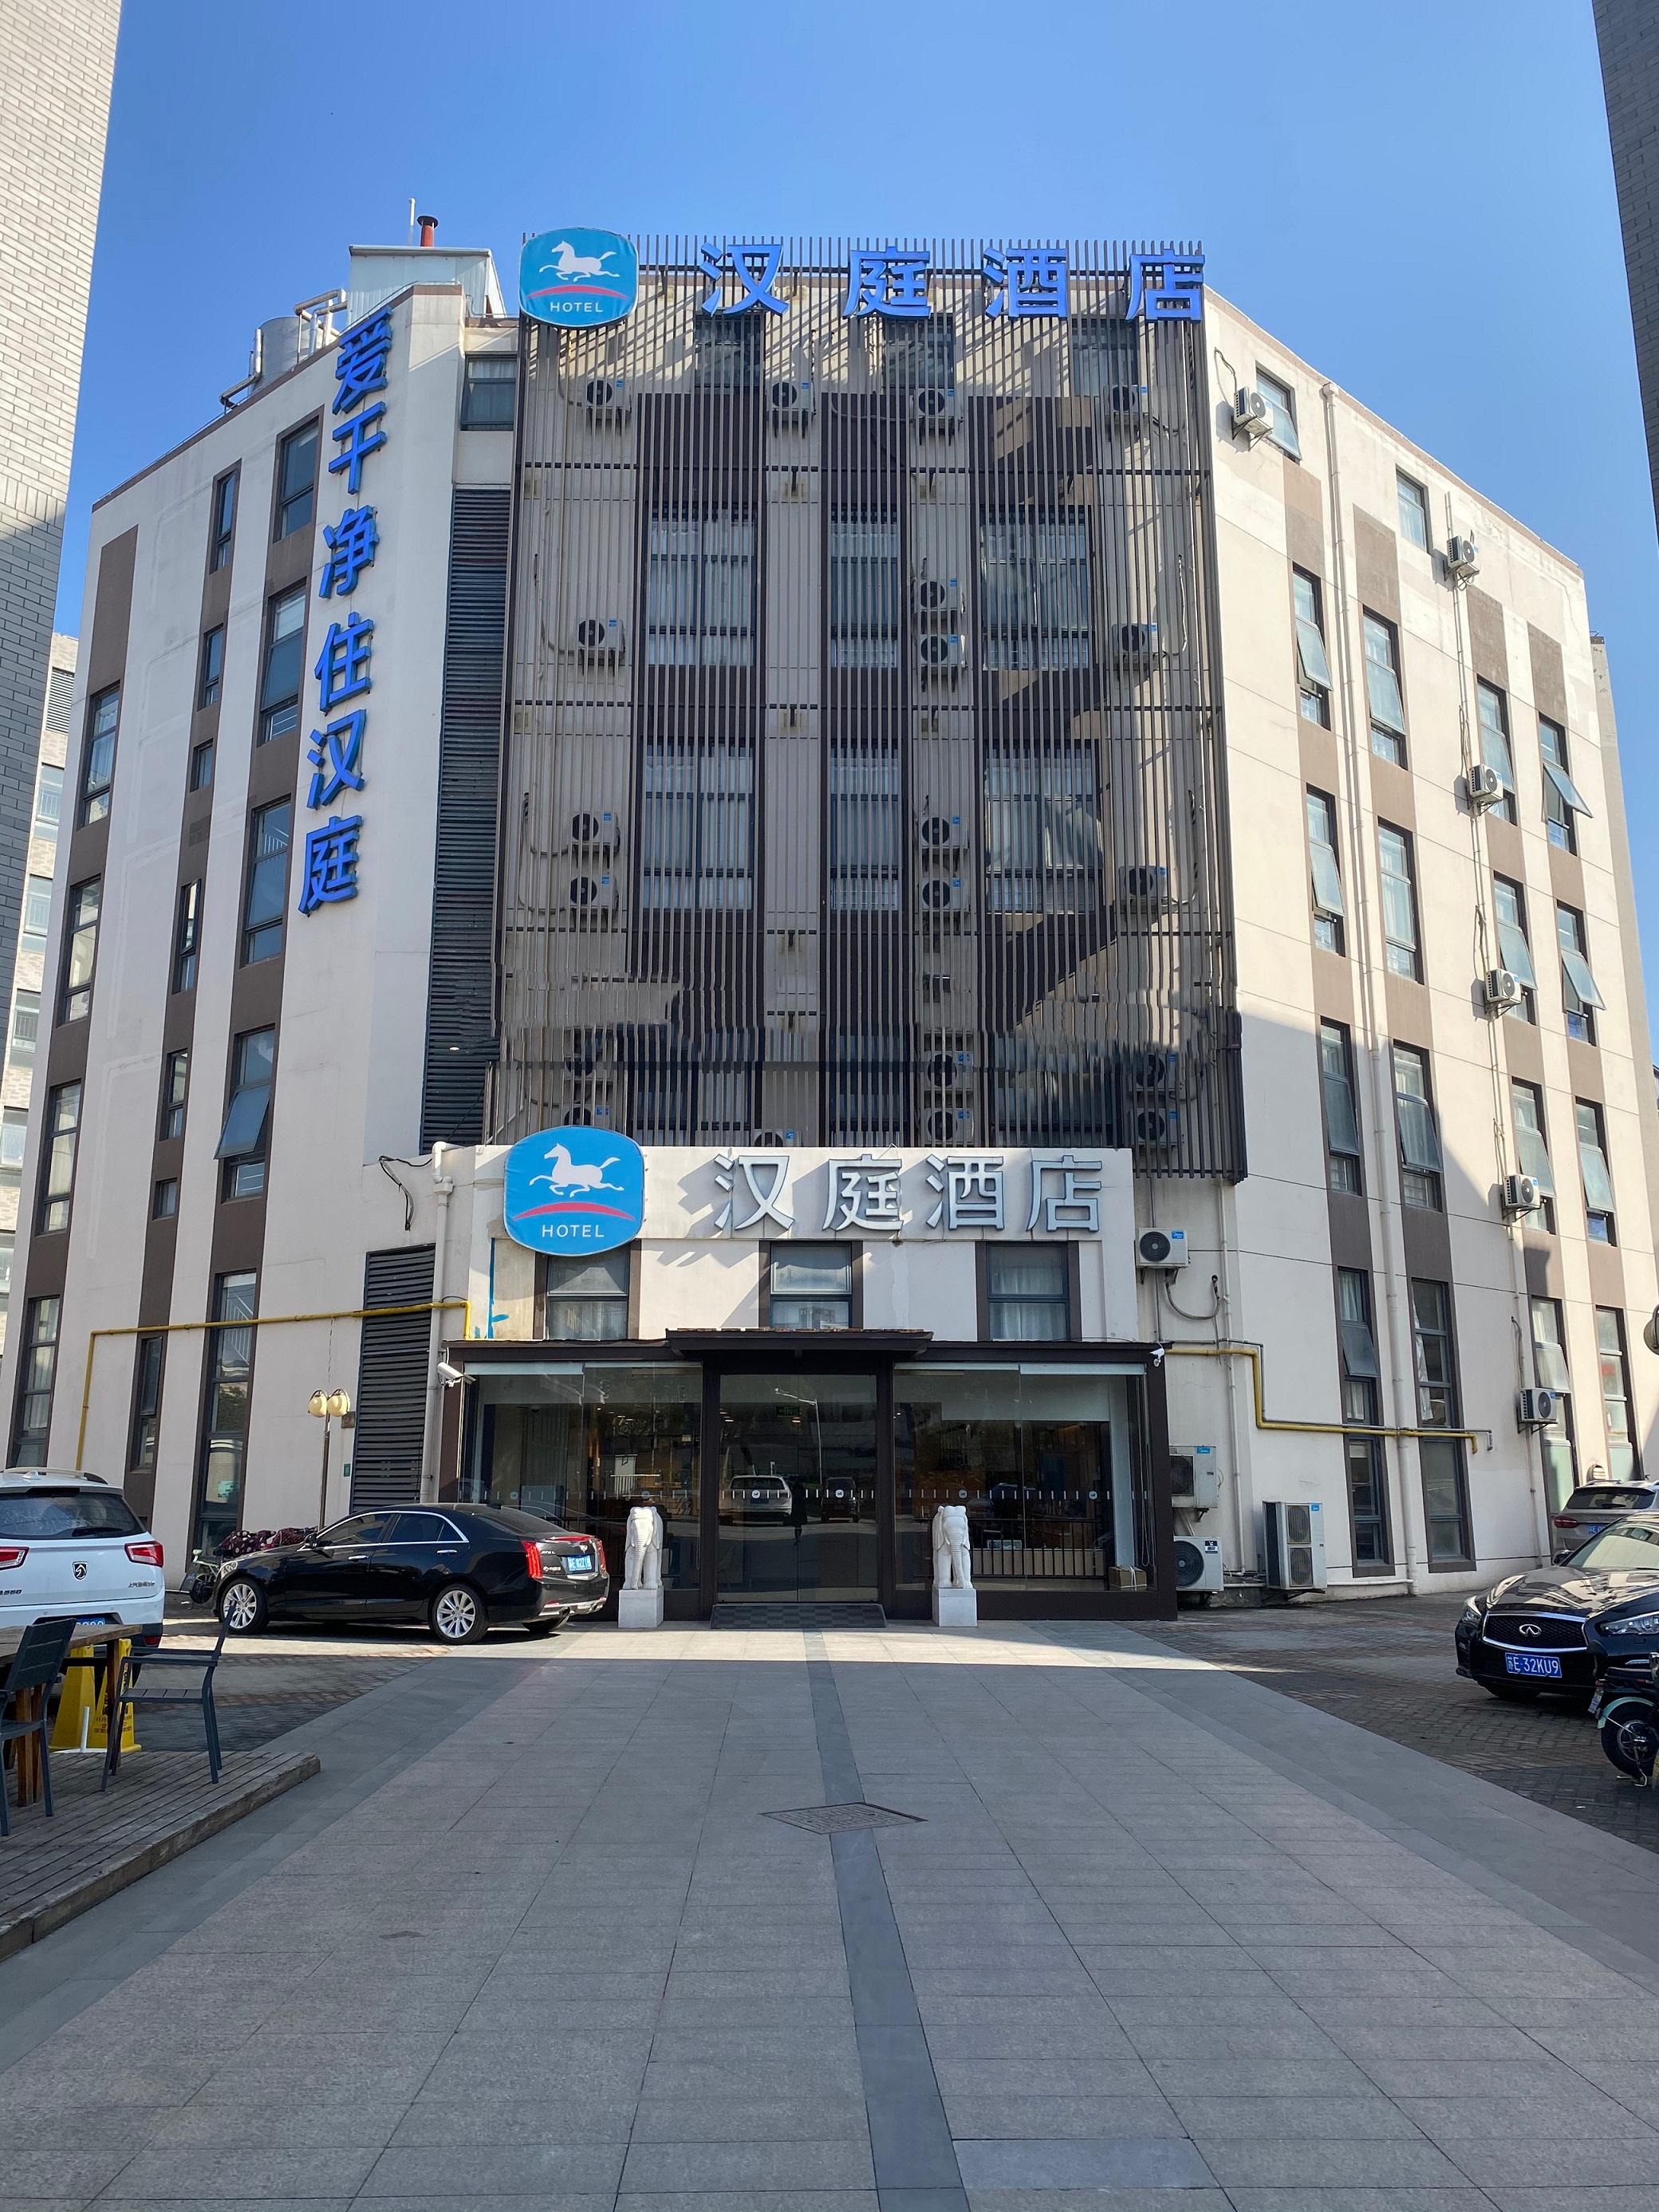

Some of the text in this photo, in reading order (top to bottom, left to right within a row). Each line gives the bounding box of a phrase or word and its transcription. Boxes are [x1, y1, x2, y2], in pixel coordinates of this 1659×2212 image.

[550, 302, 603, 313] HOTEL
[700, 243, 1206, 322] 汉庭酒店
[298, 305, 394, 916] 爱干净住汉庭
[542, 1224, 605, 1238] HOTEL
[714, 1153, 1102, 1232] 汉庭酒店
